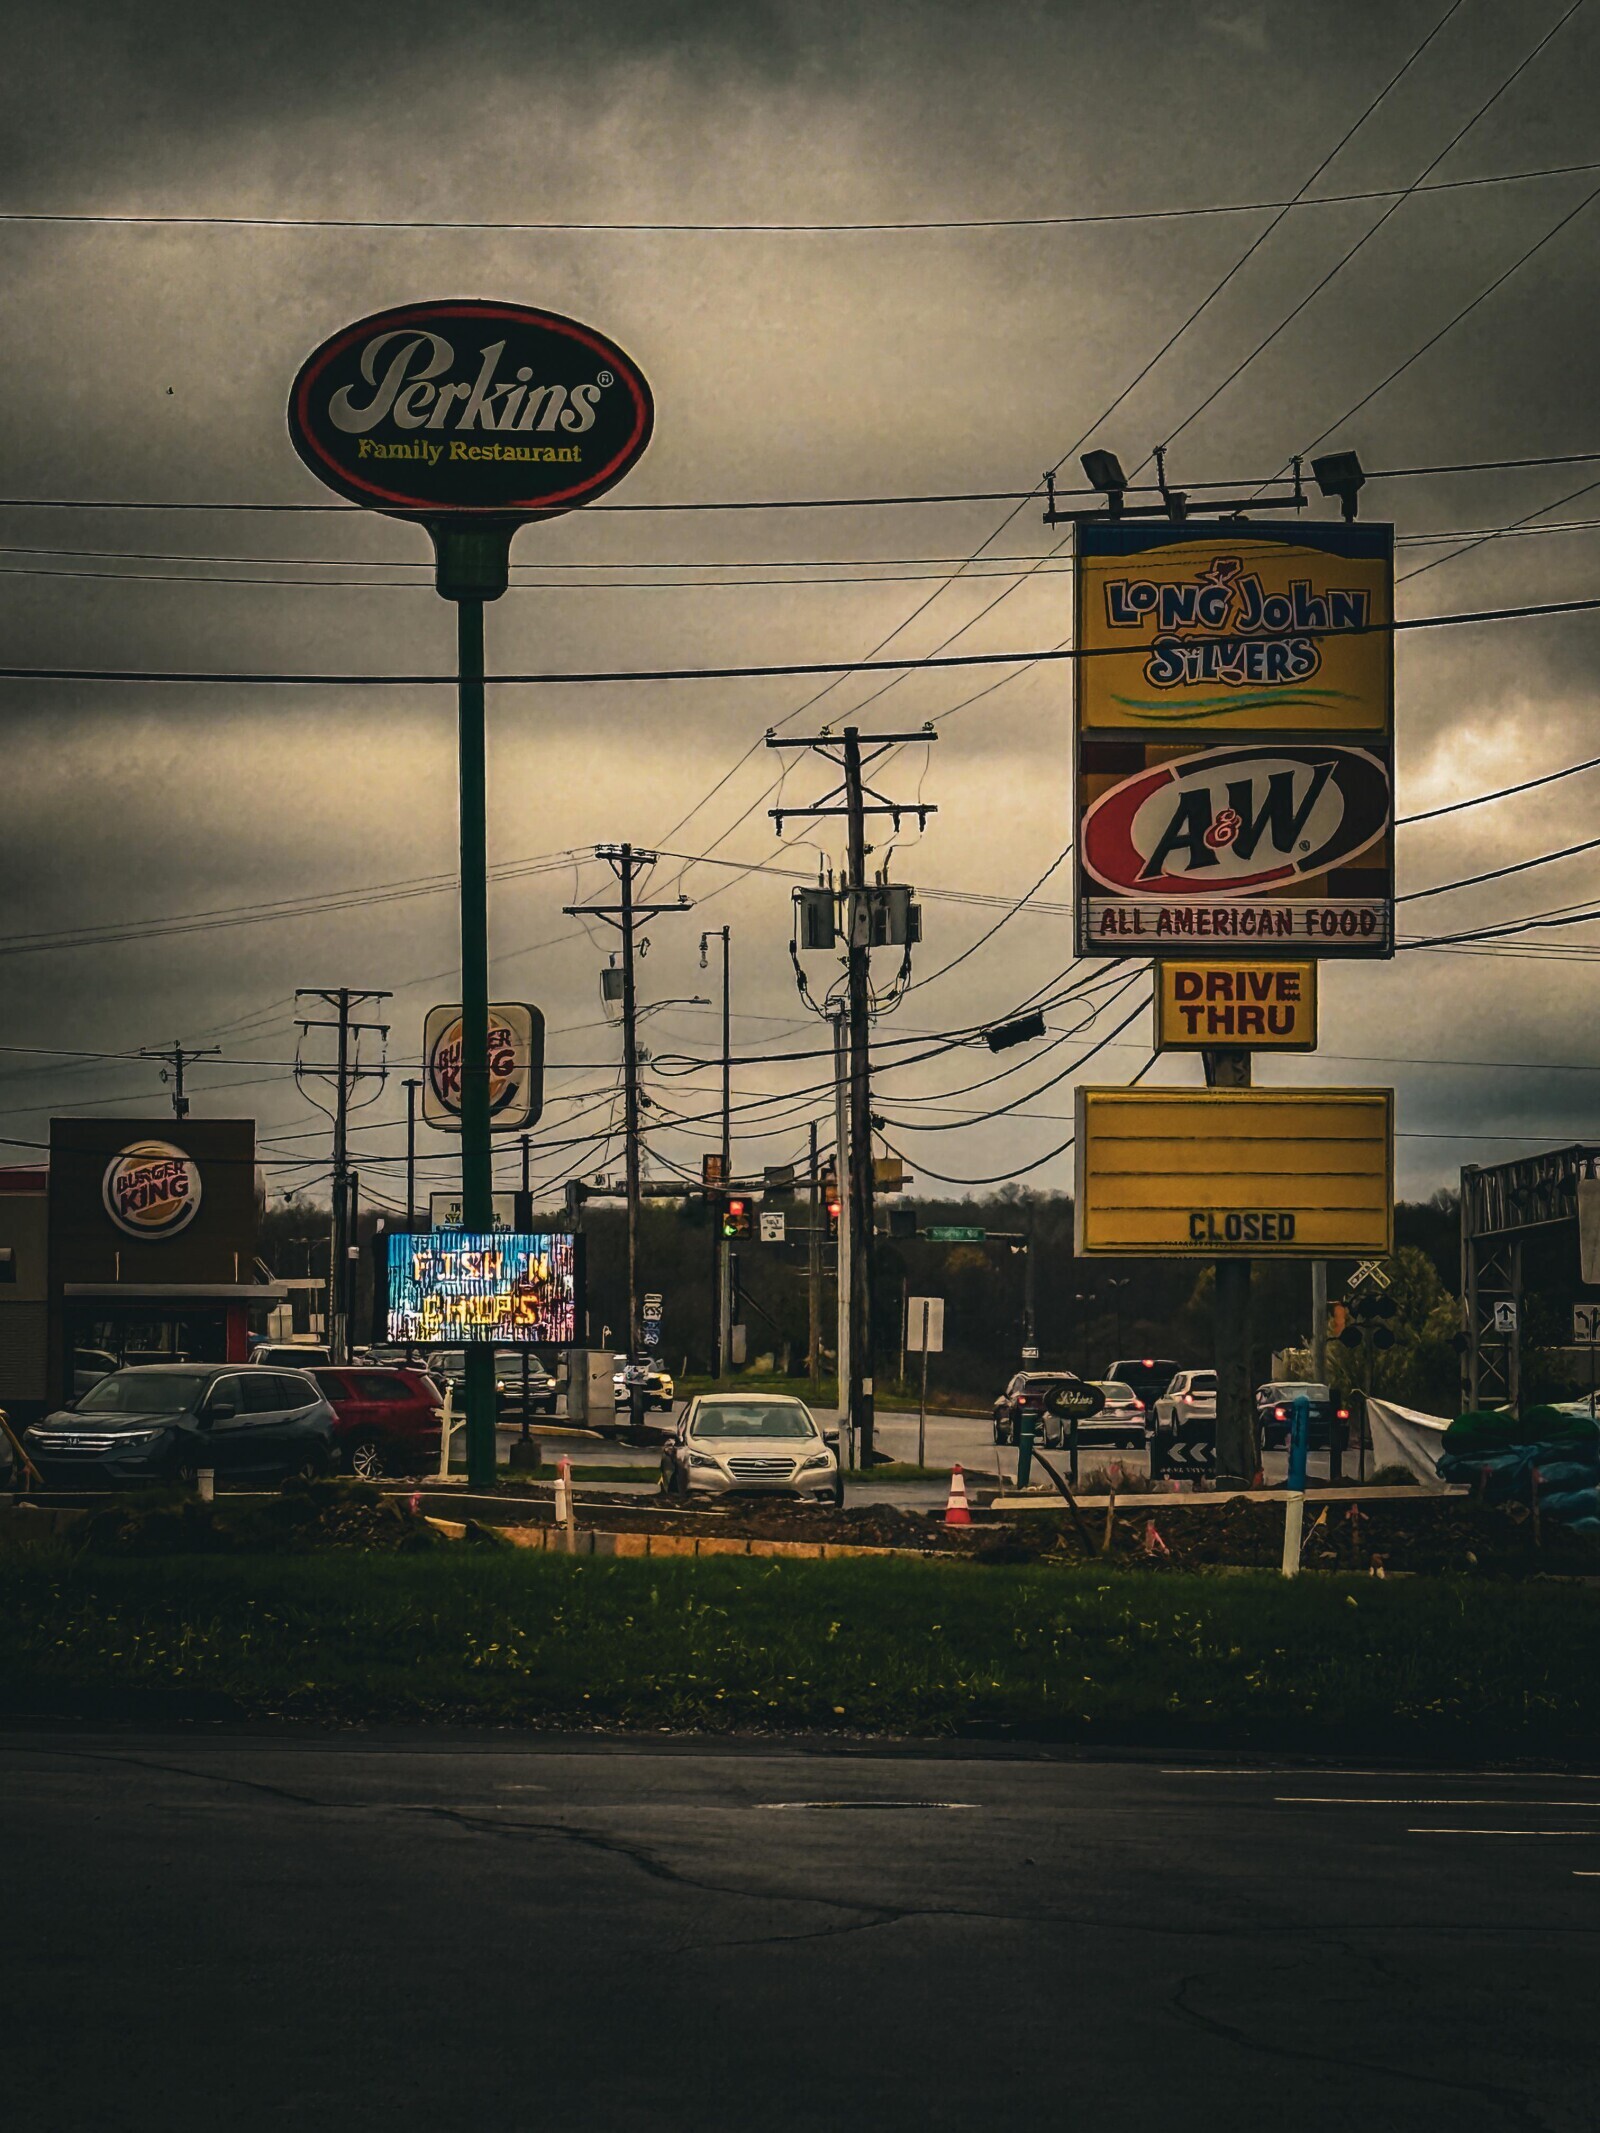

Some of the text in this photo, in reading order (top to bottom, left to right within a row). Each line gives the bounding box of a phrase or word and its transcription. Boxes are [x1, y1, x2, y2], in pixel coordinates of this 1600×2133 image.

[328, 329, 602, 434] Perkins
[358, 439, 583, 466] Family Restaurant
[1134, 760, 1340, 883] A&W
[1100, 907, 1379, 938] ALL AMERICAN FOOD
[1174, 971, 1301, 1002] DRIVE
[1179, 1005, 1296, 1035] THRU
[116, 1160, 187, 1195] BURGER
[120, 1175, 189, 1216] KING
[1189, 1213, 1296, 1241] CLOSED
